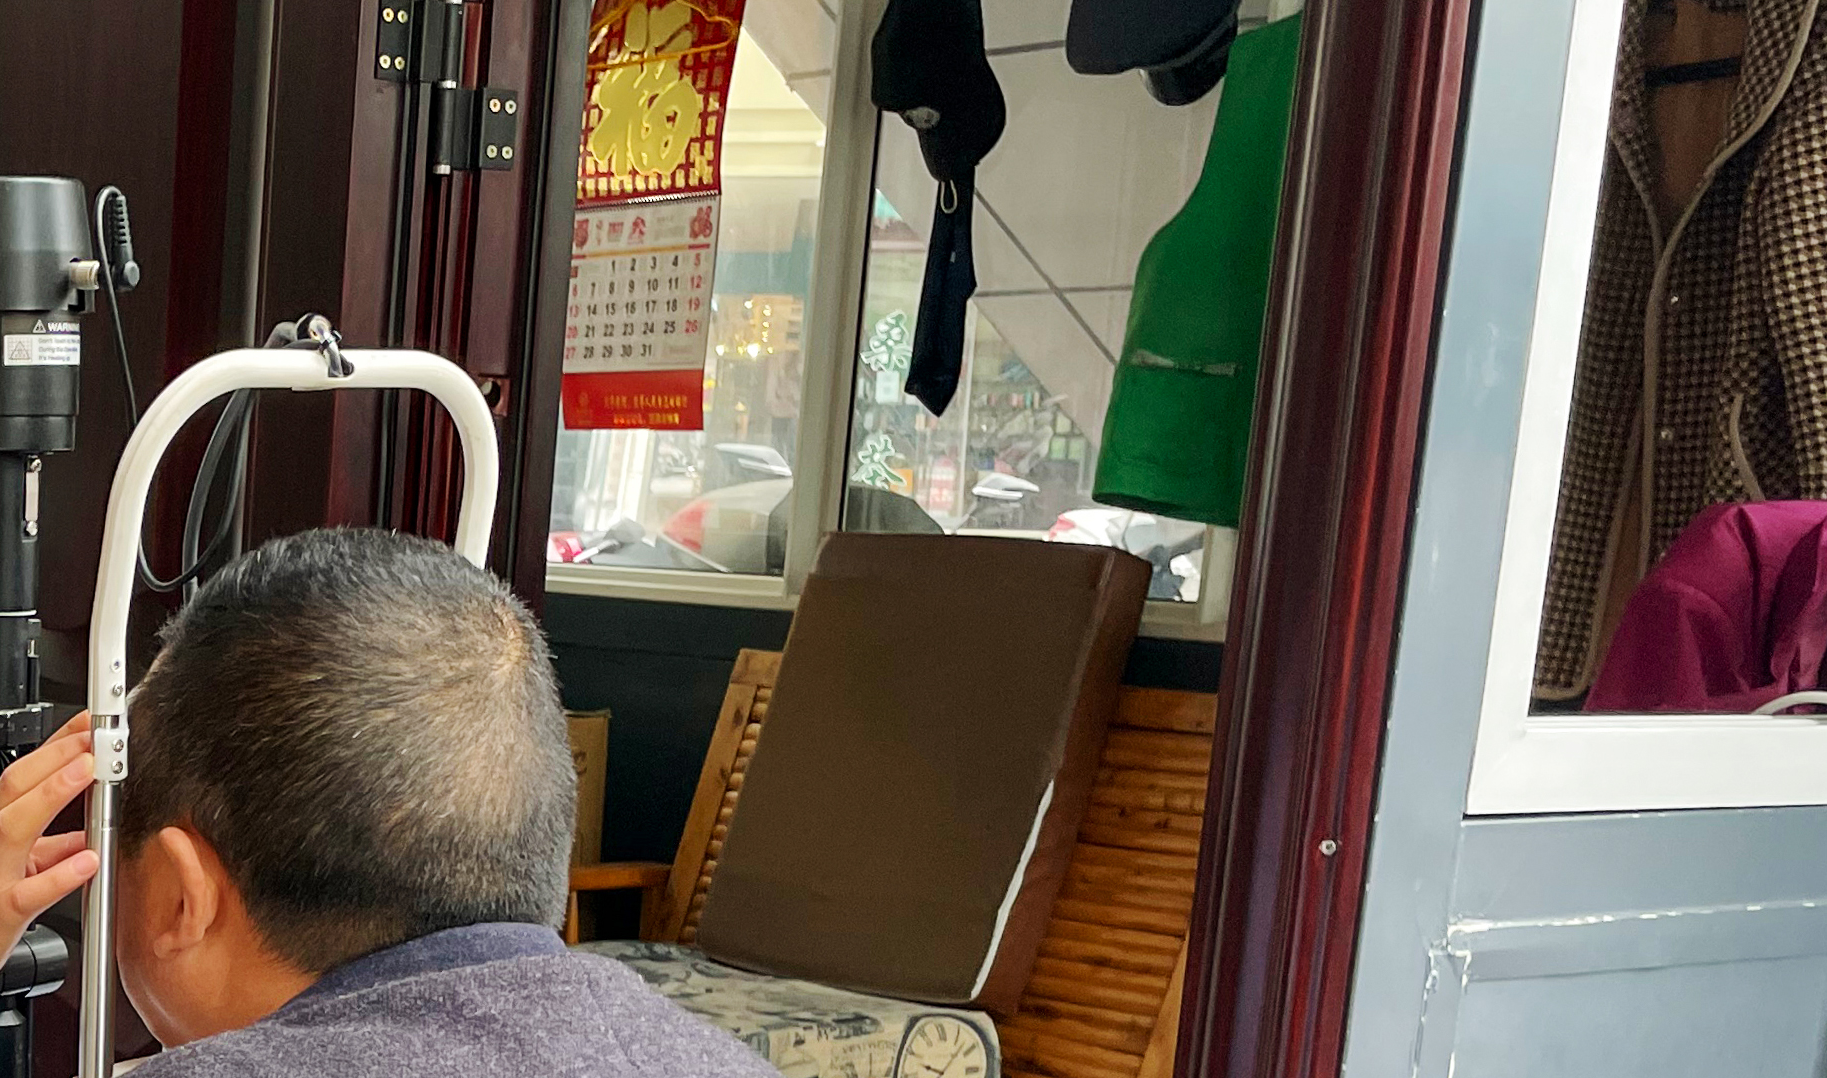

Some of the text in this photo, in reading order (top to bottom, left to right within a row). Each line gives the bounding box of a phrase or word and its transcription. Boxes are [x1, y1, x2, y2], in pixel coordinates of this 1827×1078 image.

[591, 0, 701, 177] 福
[647, 279, 658, 292] 10
[669, 277, 678, 290] 11
[691, 275, 702, 289] 12
[587, 304, 597, 316] 14
[606, 303, 616, 315] 15
[626, 302, 636, 314] 16
[646, 300, 656, 312] 17
[667, 298, 677, 312] 18
[689, 297, 700, 310] 19
[585, 325, 595, 338] 21
[604, 323, 614, 337] 22
[623, 322, 633, 336] 23
[643, 322, 654, 335] 24
[664, 321, 675, 334] 25
[685, 320, 697, 334] 26
[584, 346, 594, 359] 28
[602, 345, 613, 358] 29
[621, 344, 632, 357] 30
[641, 344, 652, 356] 31
